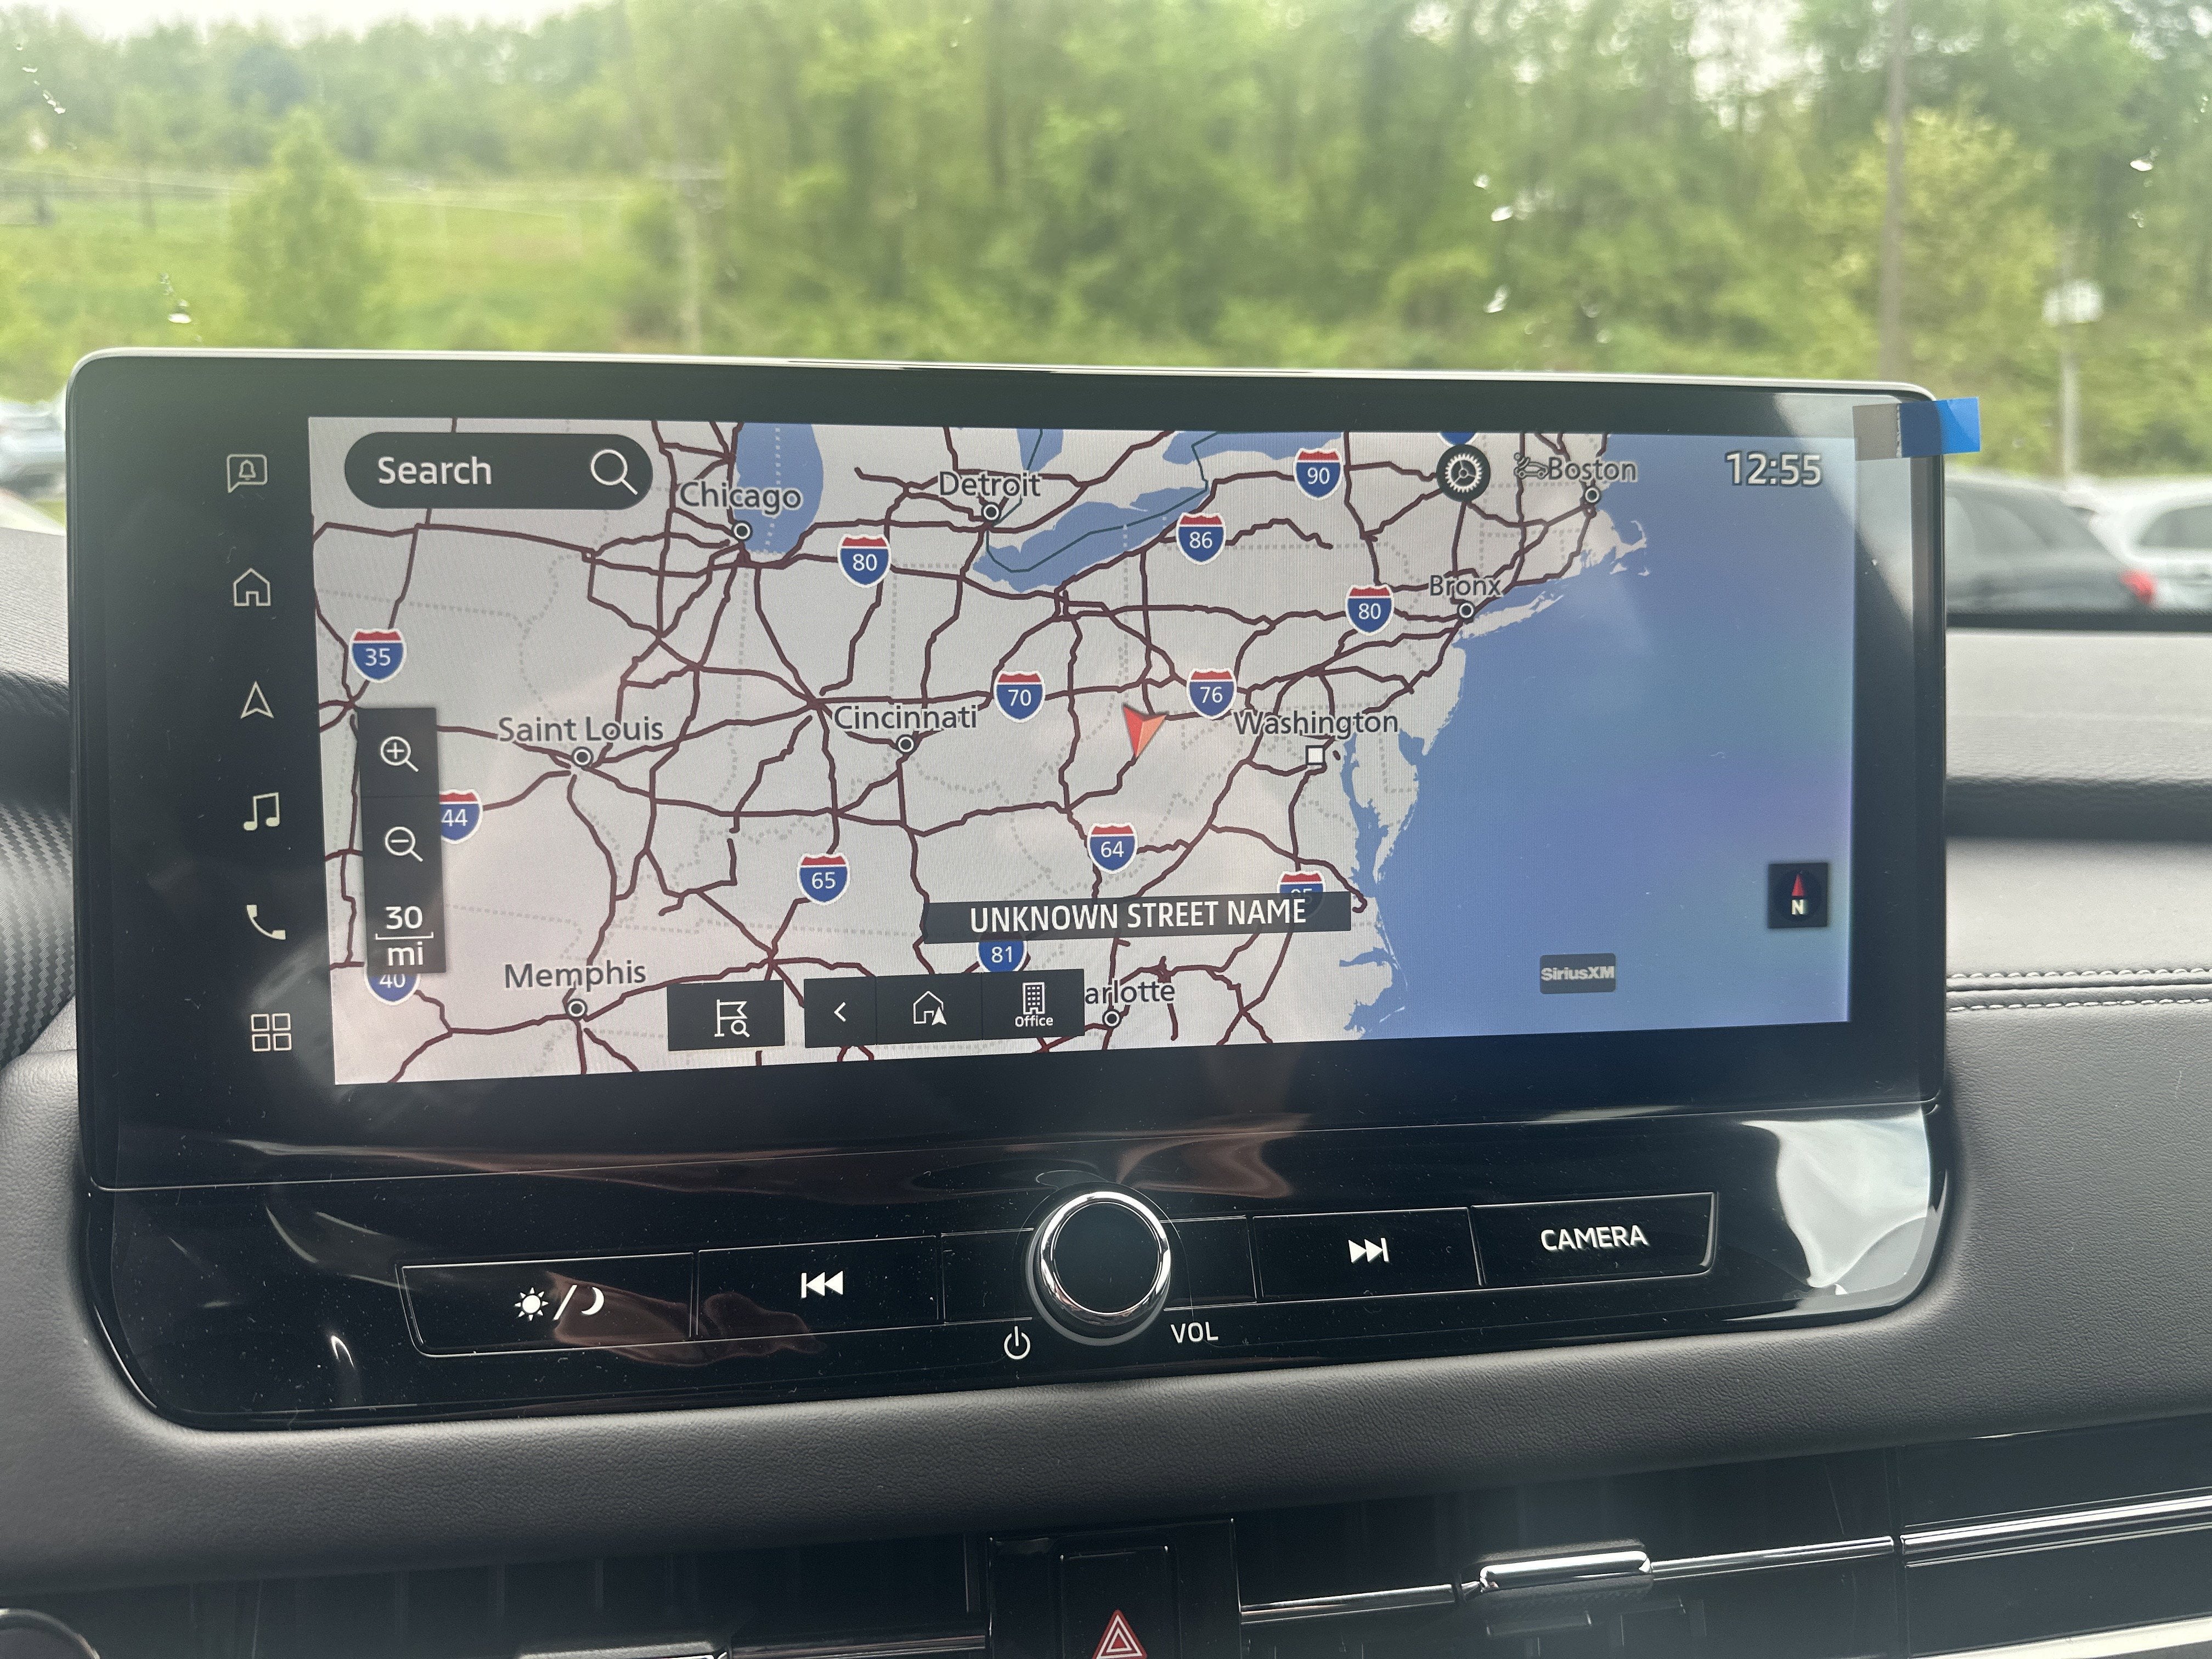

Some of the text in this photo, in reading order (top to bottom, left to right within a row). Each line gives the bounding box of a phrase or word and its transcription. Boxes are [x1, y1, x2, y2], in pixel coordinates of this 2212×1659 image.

[378, 456, 492, 485] Search
[1306, 467, 1330, 484] 90
[1548, 459, 1638, 482] Boston
[1725, 452, 1821, 487] 12:55
[939, 472, 1041, 497] Detroit
[680, 481, 802, 514] Chicago
[1188, 533, 1213, 550] 86
[852, 554, 878, 571] 80
[1430, 575, 1502, 597] Bronx
[1357, 603, 1381, 621] 80
[365, 648, 391, 666] 35
[1007, 690, 1032, 707] 70
[1199, 687, 1223, 704] 76
[499, 716, 665, 742] Saint Louis
[834, 703, 979, 733] Cincinnati
[1234, 711, 1399, 738] Washington
[442, 809, 468, 827] 44
[1099, 842, 1125, 859] 64
[810, 872, 836, 889] 65
[385, 905, 424, 929] 30
[970, 899, 1307, 933] UNKNOWN STREET NAME
[1791, 899, 1804, 915] N
[387, 941, 424, 966] mi
[991, 946, 1013, 963] 81
[504, 960, 647, 992] Memphis
[1541, 966, 1615, 981] SiriusXM
[1085, 980, 1175, 1004] arlotte
[1014, 1015, 1054, 1028] Office
[1541, 1224, 1648, 1252] CAMERA
[1170, 1322, 1219, 1344] VOL
